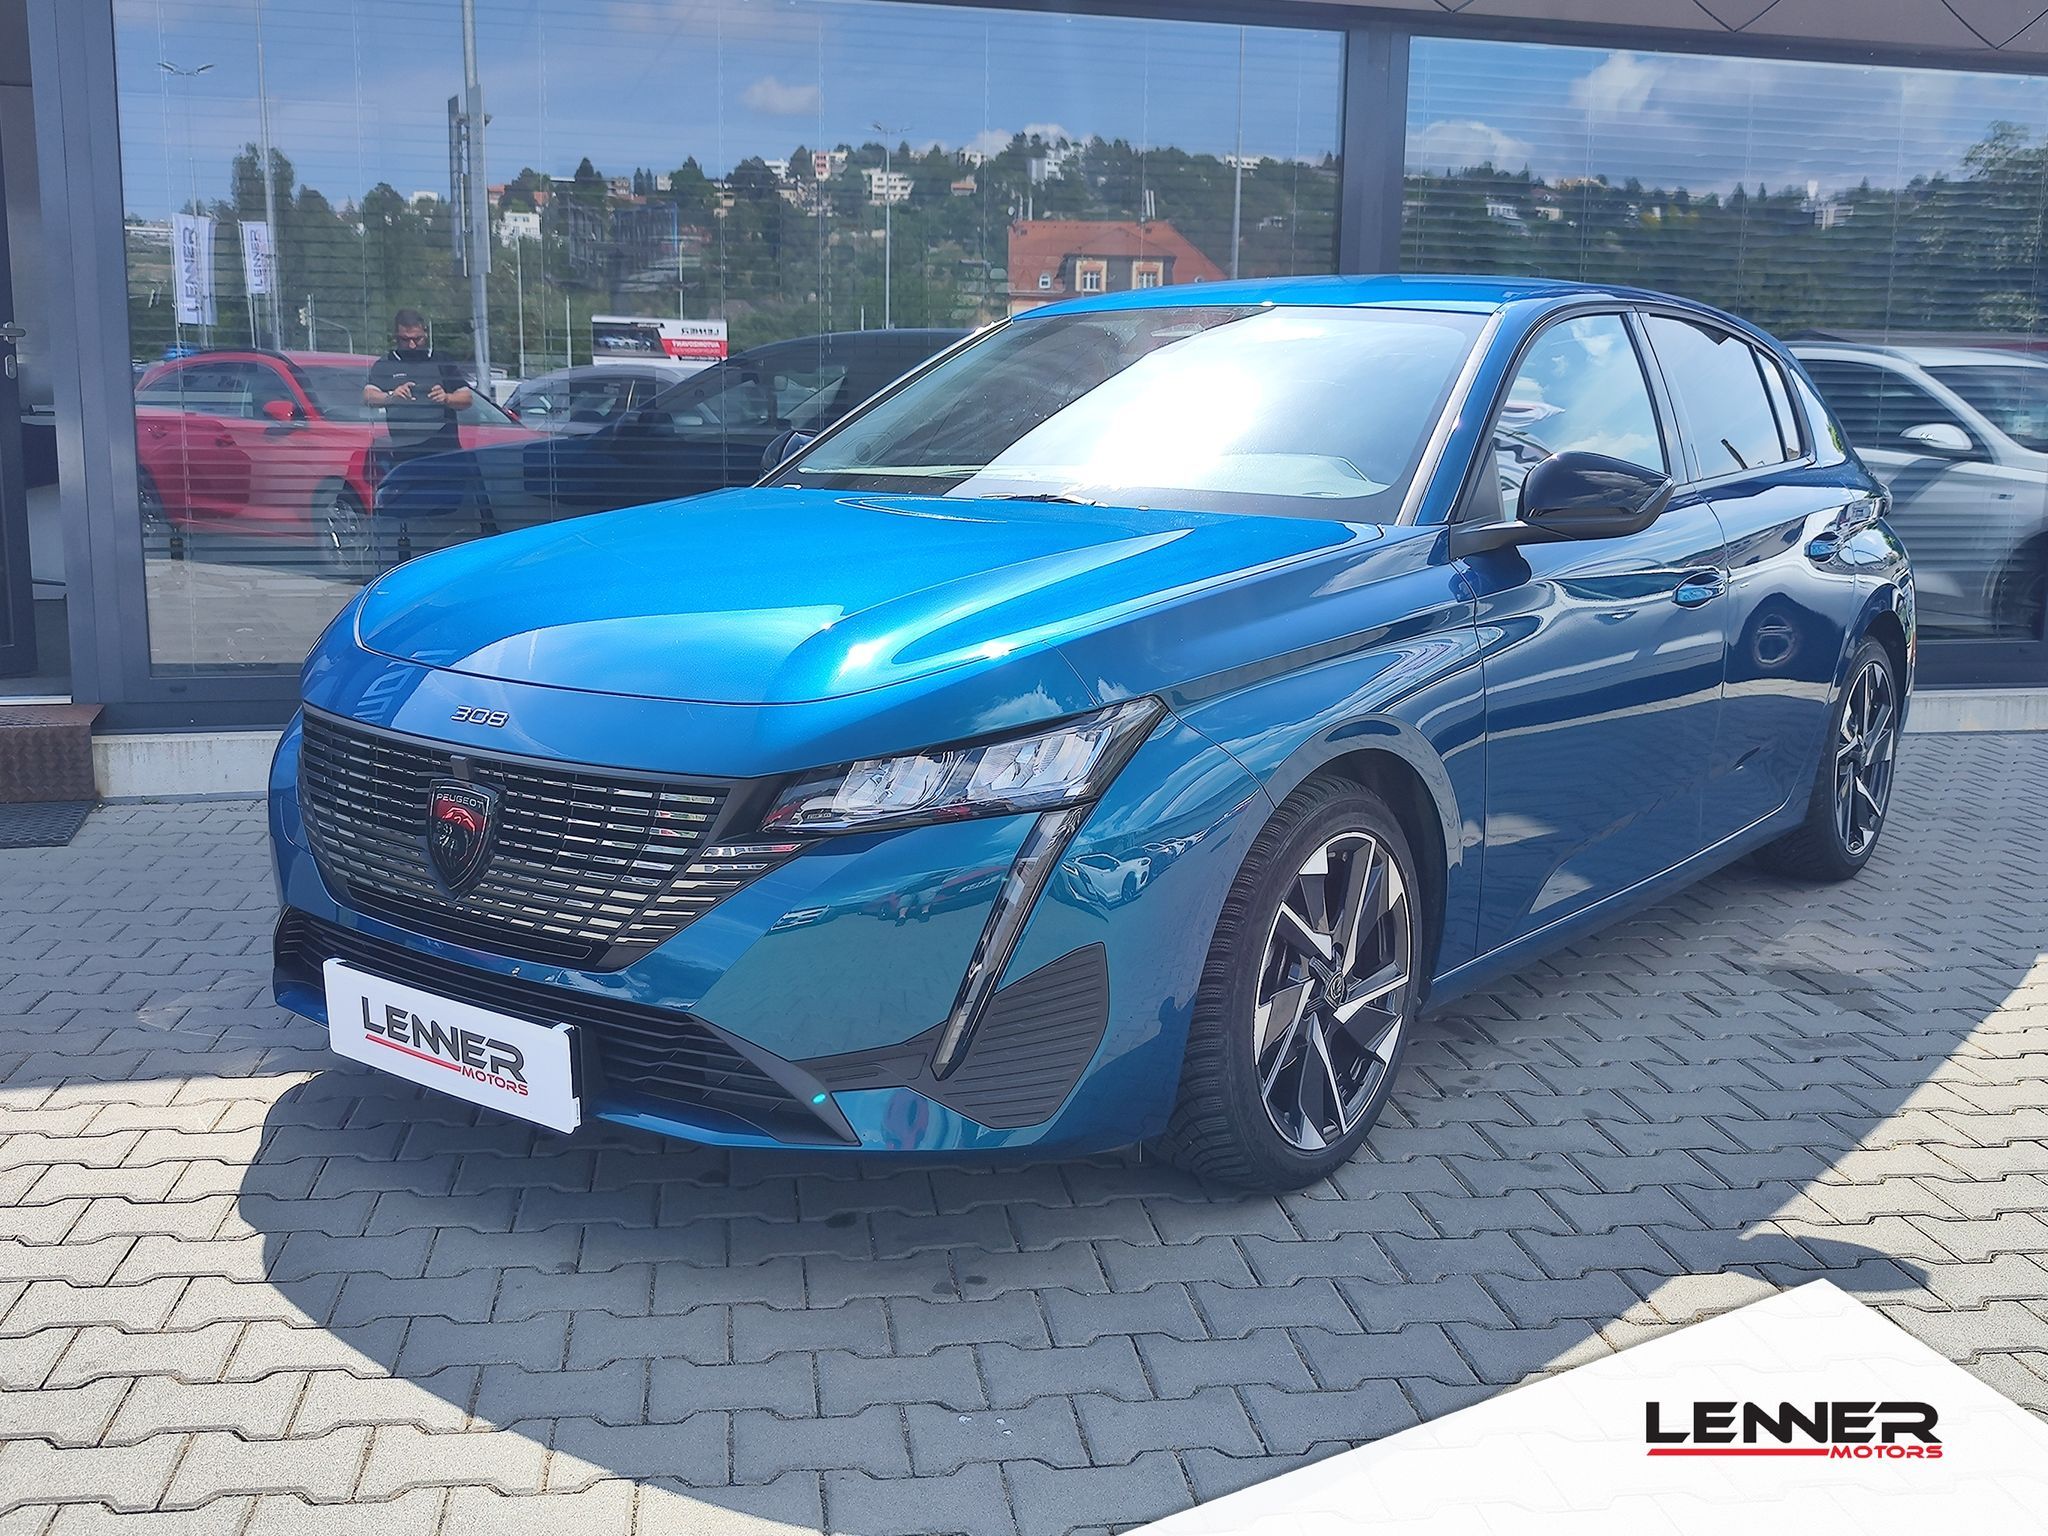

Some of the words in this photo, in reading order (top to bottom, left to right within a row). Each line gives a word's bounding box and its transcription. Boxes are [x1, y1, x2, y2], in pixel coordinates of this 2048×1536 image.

[183, 226, 201, 312] LENNER
[451, 705, 509, 727] 308
[436, 793, 485, 809] PEUGEOT
[361, 995, 529, 1084] LENNER
[461, 1065, 530, 1097] MOTORS
